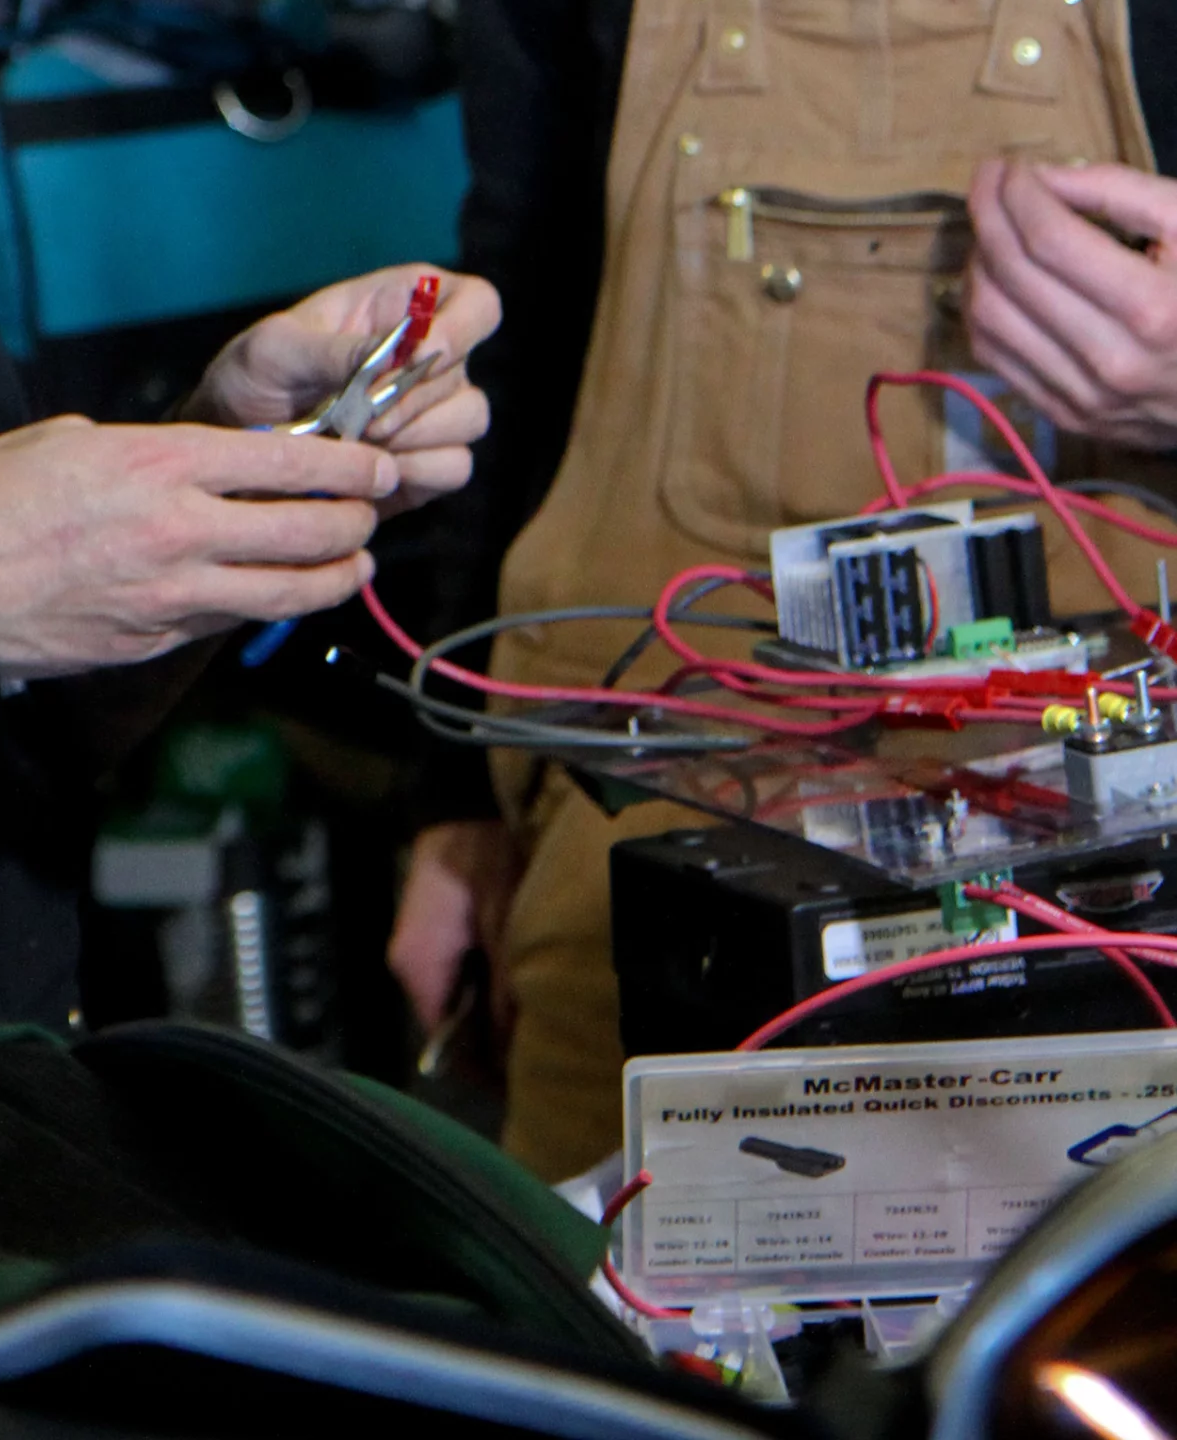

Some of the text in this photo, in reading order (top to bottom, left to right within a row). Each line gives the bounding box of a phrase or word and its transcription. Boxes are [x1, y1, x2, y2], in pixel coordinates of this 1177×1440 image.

[661, 1108, 723, 1124] Fully
[732, 1101, 855, 1120] Insulated
[863, 1096, 940, 1113] Quick
[948, 1089, 1112, 1109] Disconnects
